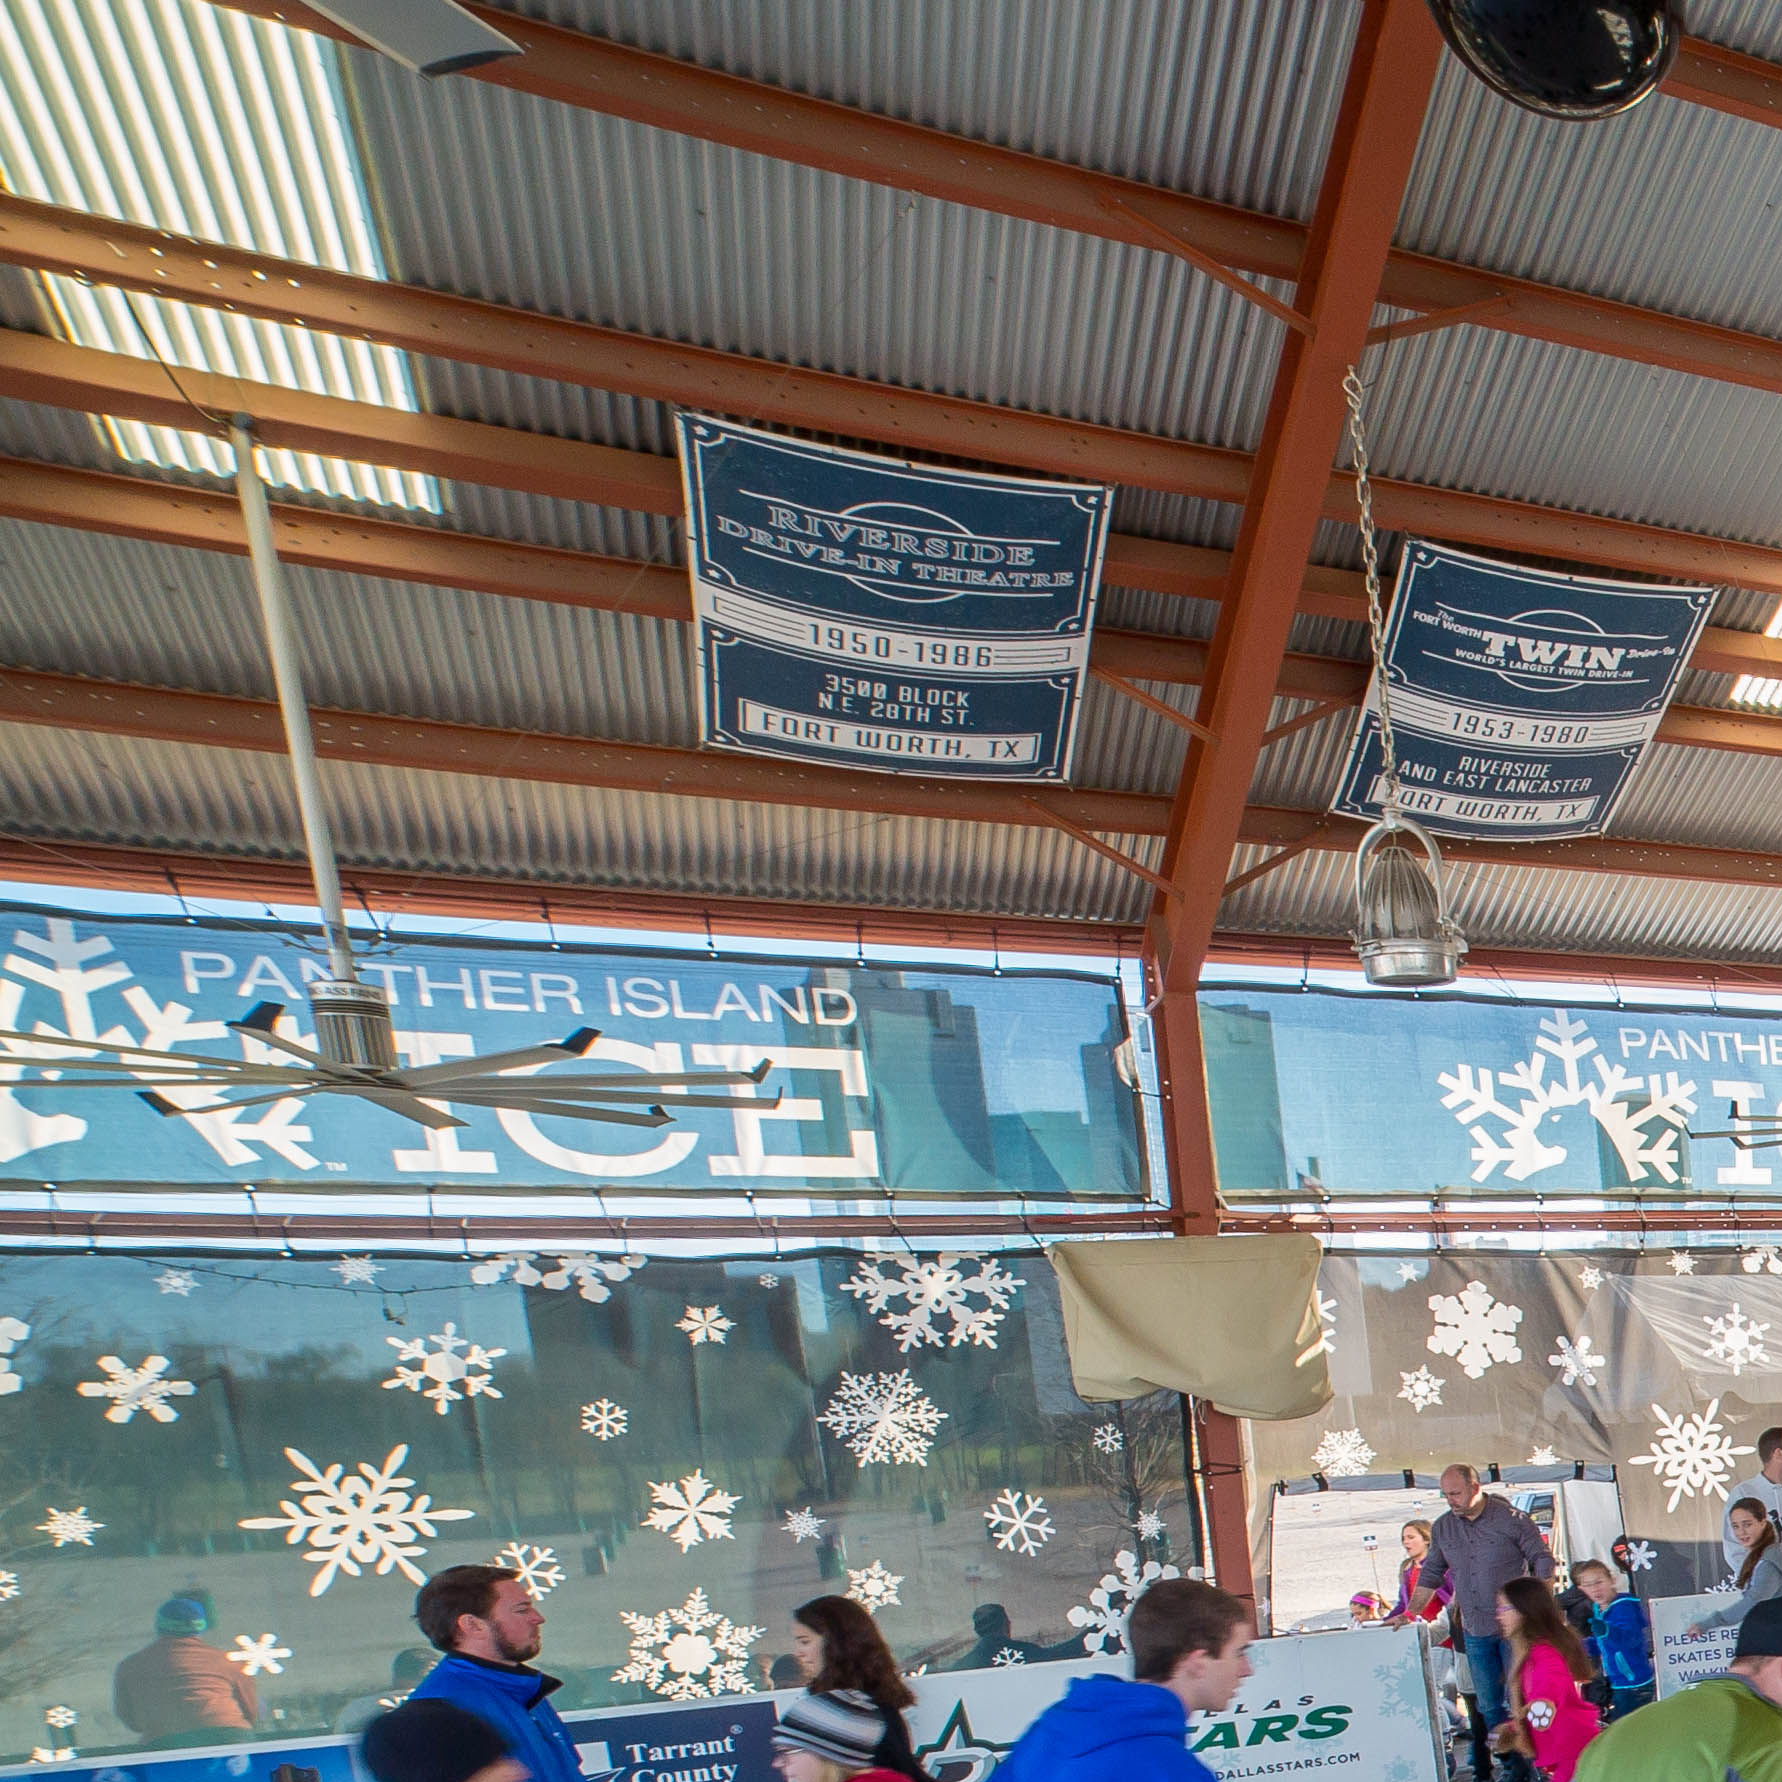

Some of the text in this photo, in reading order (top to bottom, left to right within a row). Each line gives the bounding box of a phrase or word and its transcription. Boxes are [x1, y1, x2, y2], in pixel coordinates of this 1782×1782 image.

[716, 515, 1074, 587] DRIVE-IN THEATRE
[769, 505, 1035, 566] RIVERSIDE
[807, 623, 994, 667] 1950-1986
[1413, 611, 1442, 627] FORT
[1441, 620, 1482, 639] WORTH
[1482, 631, 1626, 670] TWIN
[1509, 660, 1554, 673] LARGEST
[1558, 667, 1586, 677] TWIN
[1587, 669, 1634, 678] DRIVE-IN
[824, 674, 970, 708] 3500 BLOCK
[818, 692, 976, 726] N.E. 28TH ST.
[763, 712, 1020, 759] FORT WORTH, TX
[1451, 712, 1589, 744] 1953-1980
[1399, 760, 1592, 793] AND EAST LANCASTER
[1458, 756, 1552, 778] RIVERSIDE
[1400, 791, 1582, 821] ORT WORTH, TX
[178, 950, 858, 1028] PANTHER ISLAND
[394, 1030, 881, 1178] ICE
[1669, 1649, 1721, 1665] SKATES
[625, 1736, 735, 1764] Tarrant
[1215, 1753, 1360, 1780] DALLASSTARS.COM
